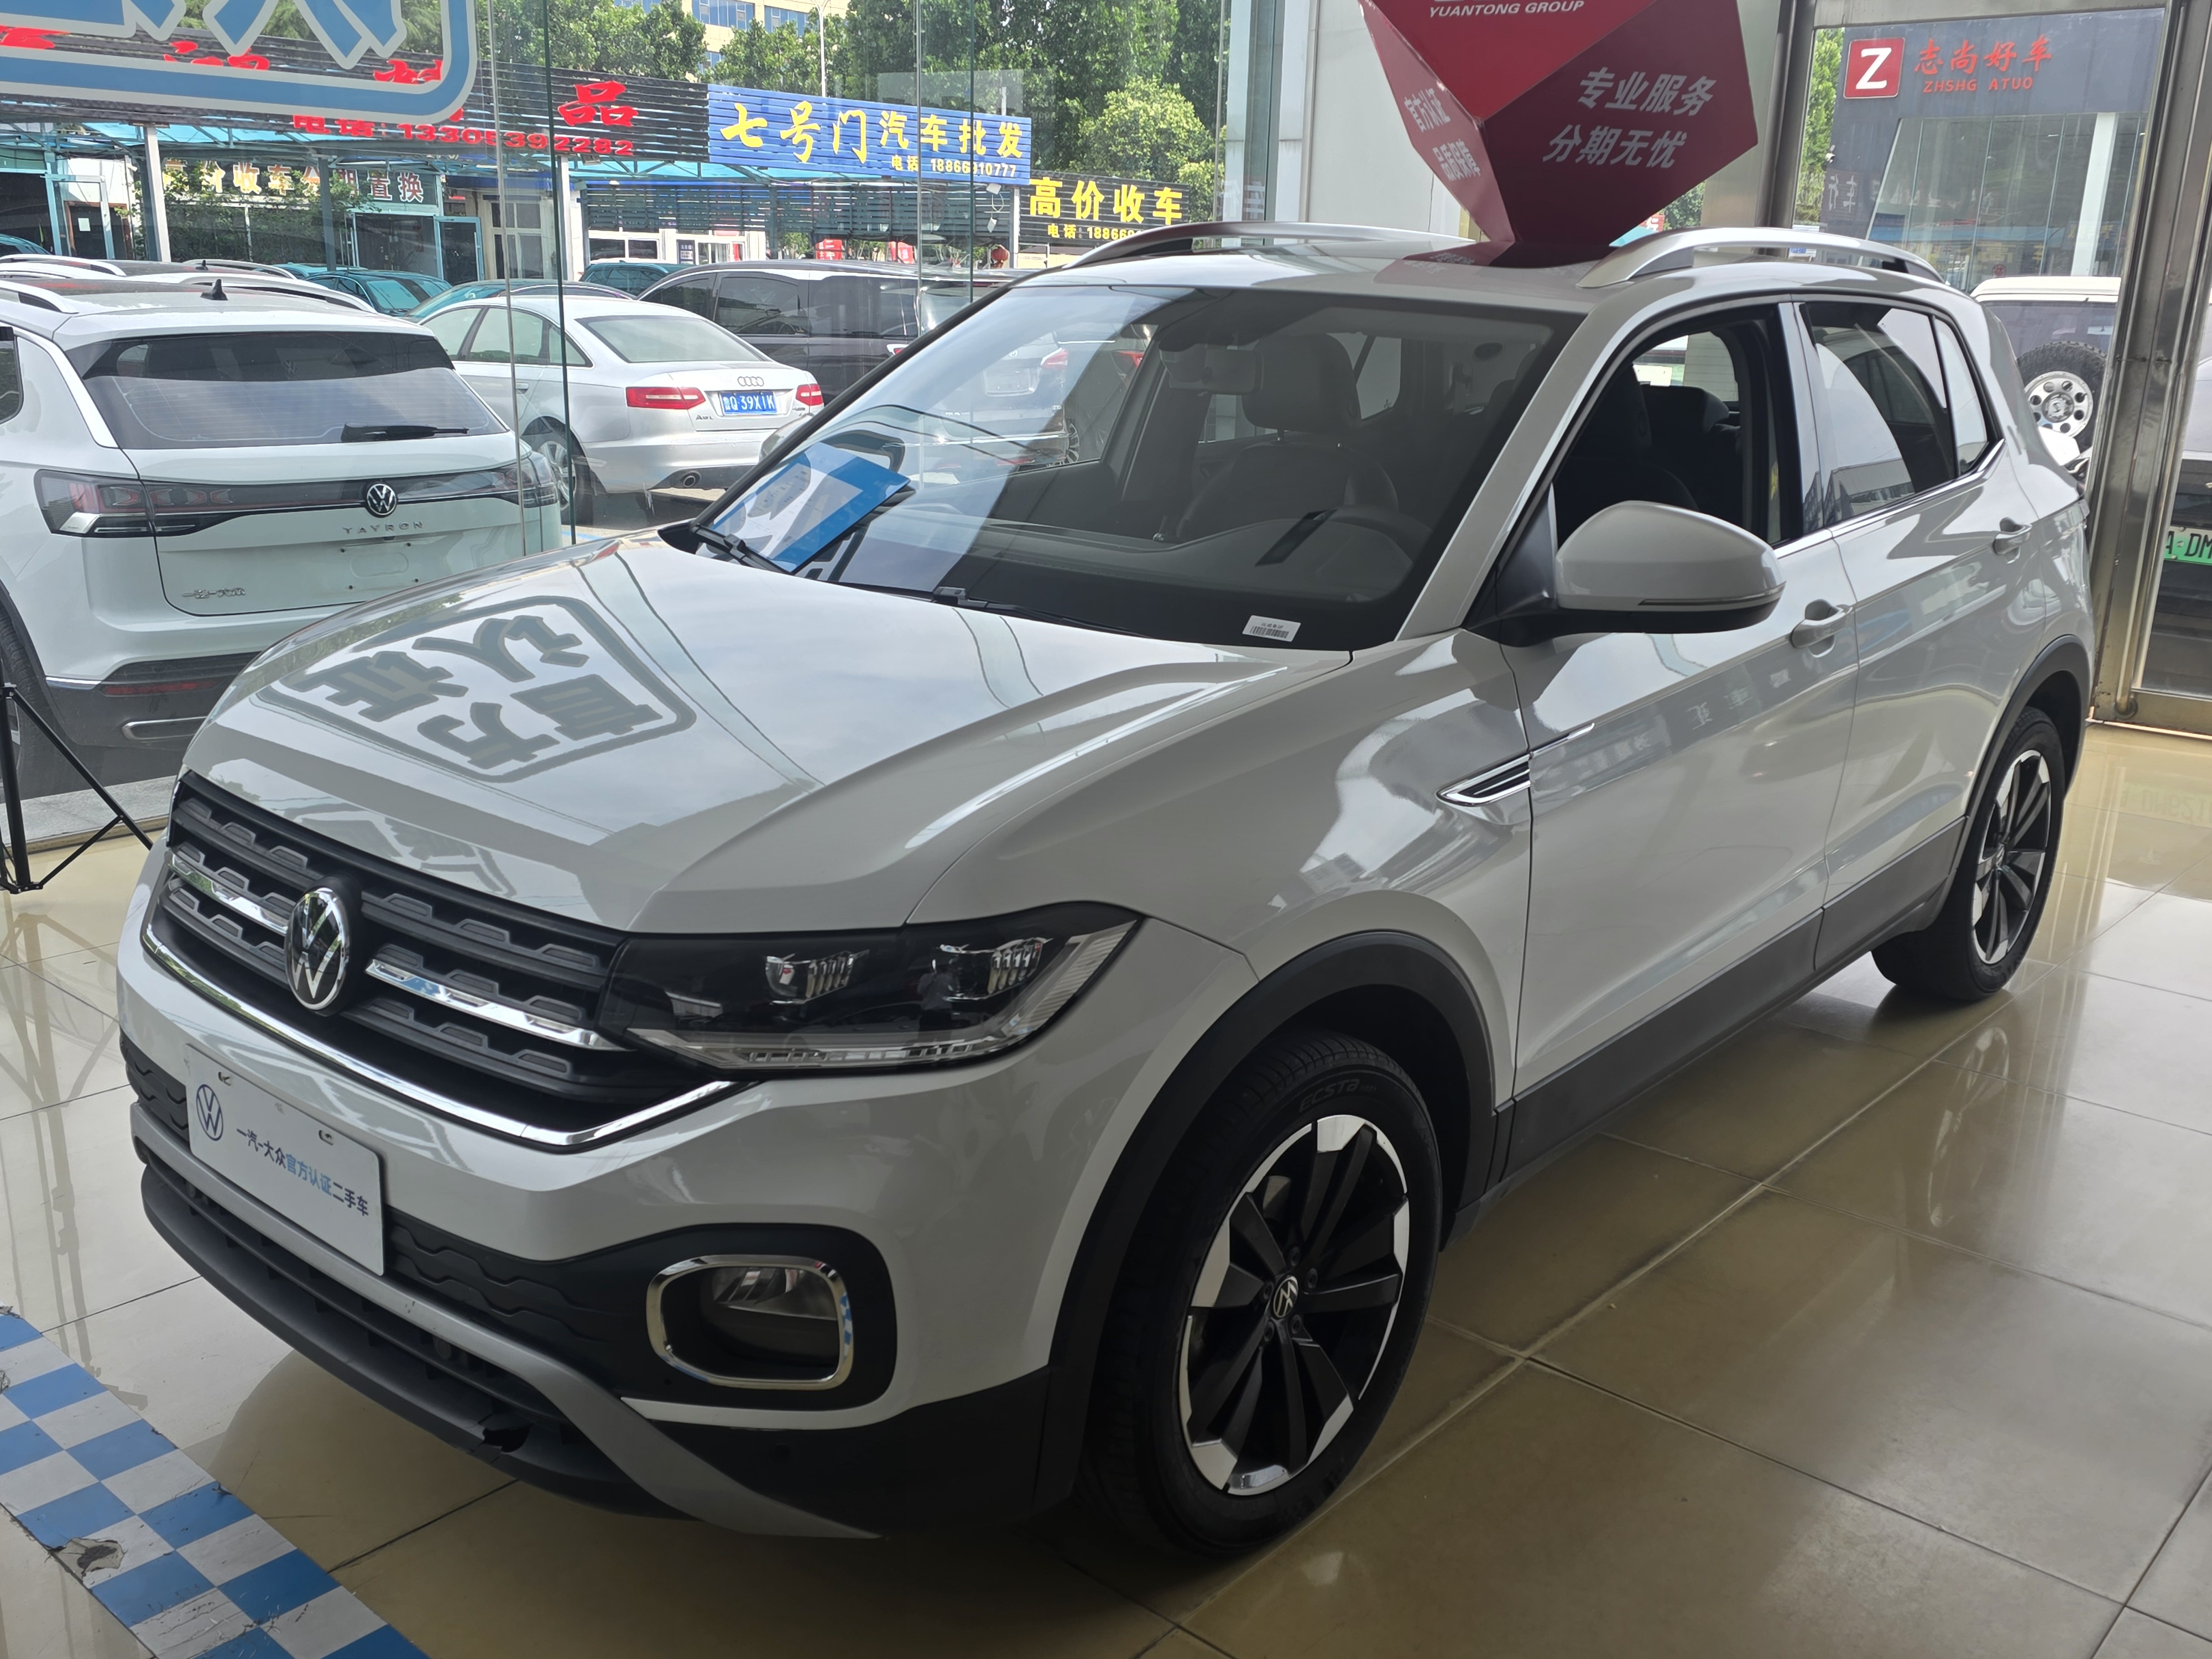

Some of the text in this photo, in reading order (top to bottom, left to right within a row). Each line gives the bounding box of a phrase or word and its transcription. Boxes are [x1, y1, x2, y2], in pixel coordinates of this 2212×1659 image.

[1430, 1, 1584, 17] YUANTONG GROUP
[1914, 34, 2052, 74] 志尚好车
[1578, 67, 1717, 116] 专业服务
[1923, 77, 2033, 92] ZHSHG ATUO
[1404, 88, 1451, 133] 官方认证
[891, 155, 918, 172] 电话
[1432, 138, 1480, 181] 品质保障
[1543, 124, 1687, 168] 分期无忧
[1029, 177, 1182, 225] 高价收车
[342, 521, 422, 534] TAYRON
